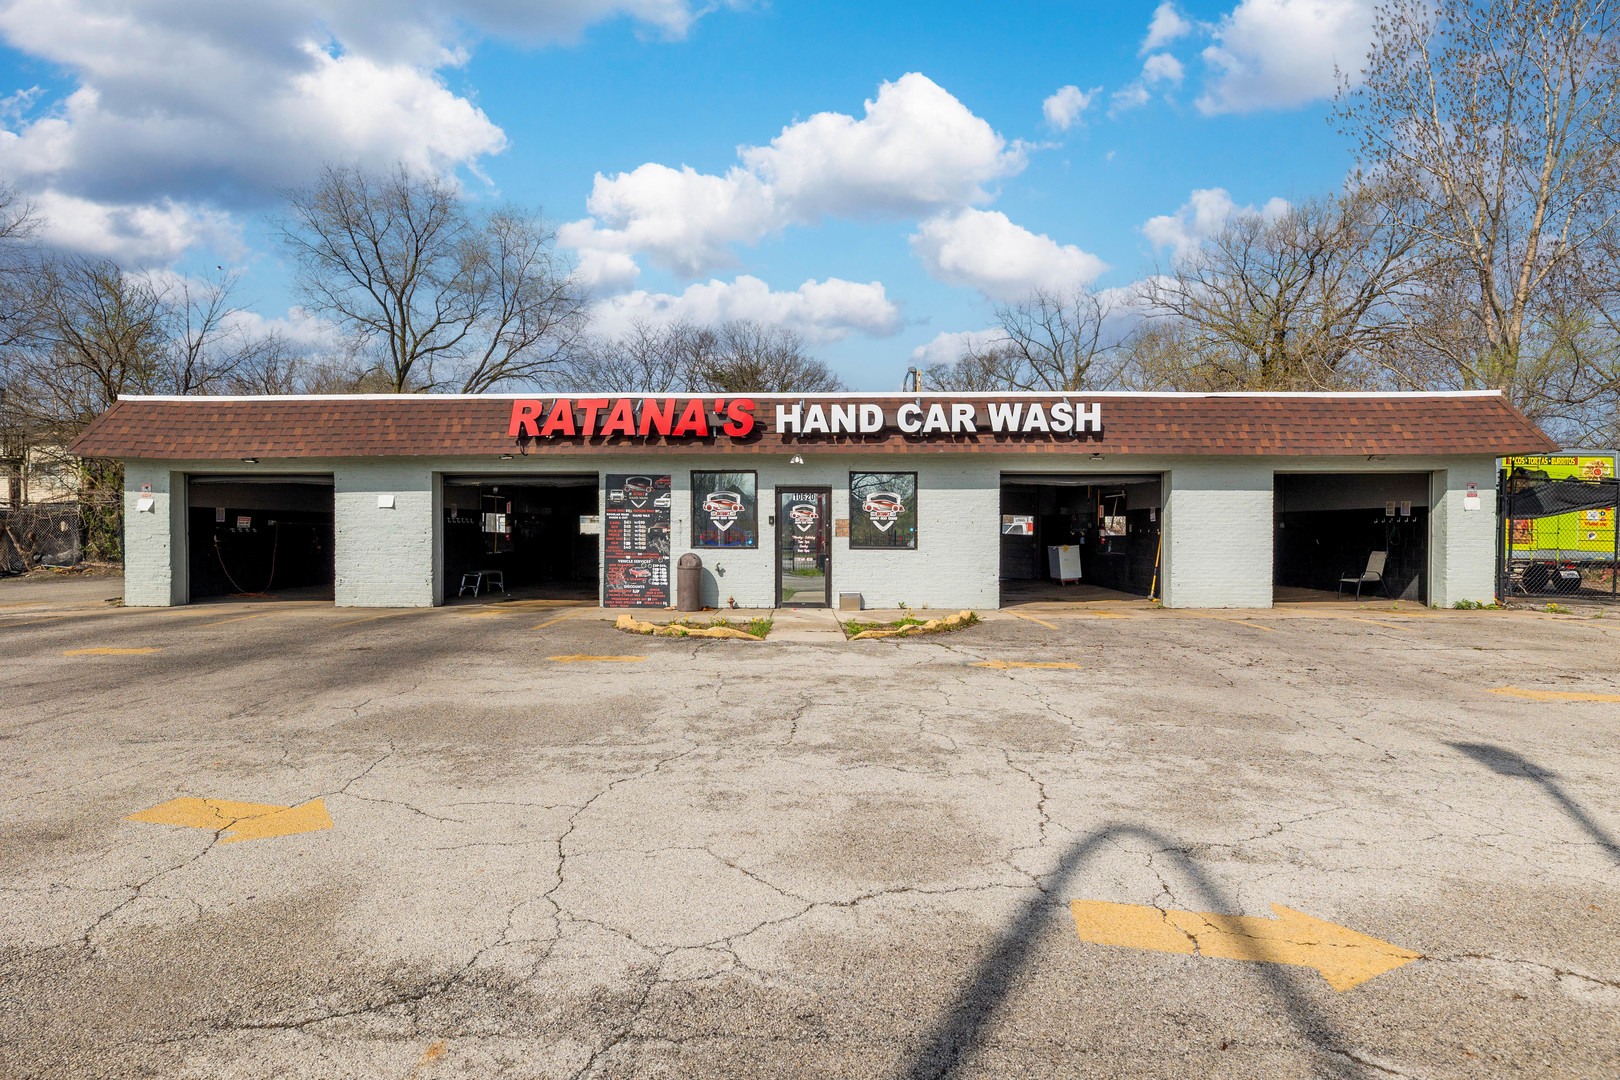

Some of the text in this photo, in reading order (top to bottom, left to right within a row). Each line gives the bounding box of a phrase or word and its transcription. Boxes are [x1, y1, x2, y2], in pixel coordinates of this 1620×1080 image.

[508, 398, 1101, 437] RATANA'S HAND CAR WASH
[1528, 457, 1549, 465] TORTAS
[1551, 457, 1576, 465] BURRITOS
[793, 493, 815, 501] 10620
